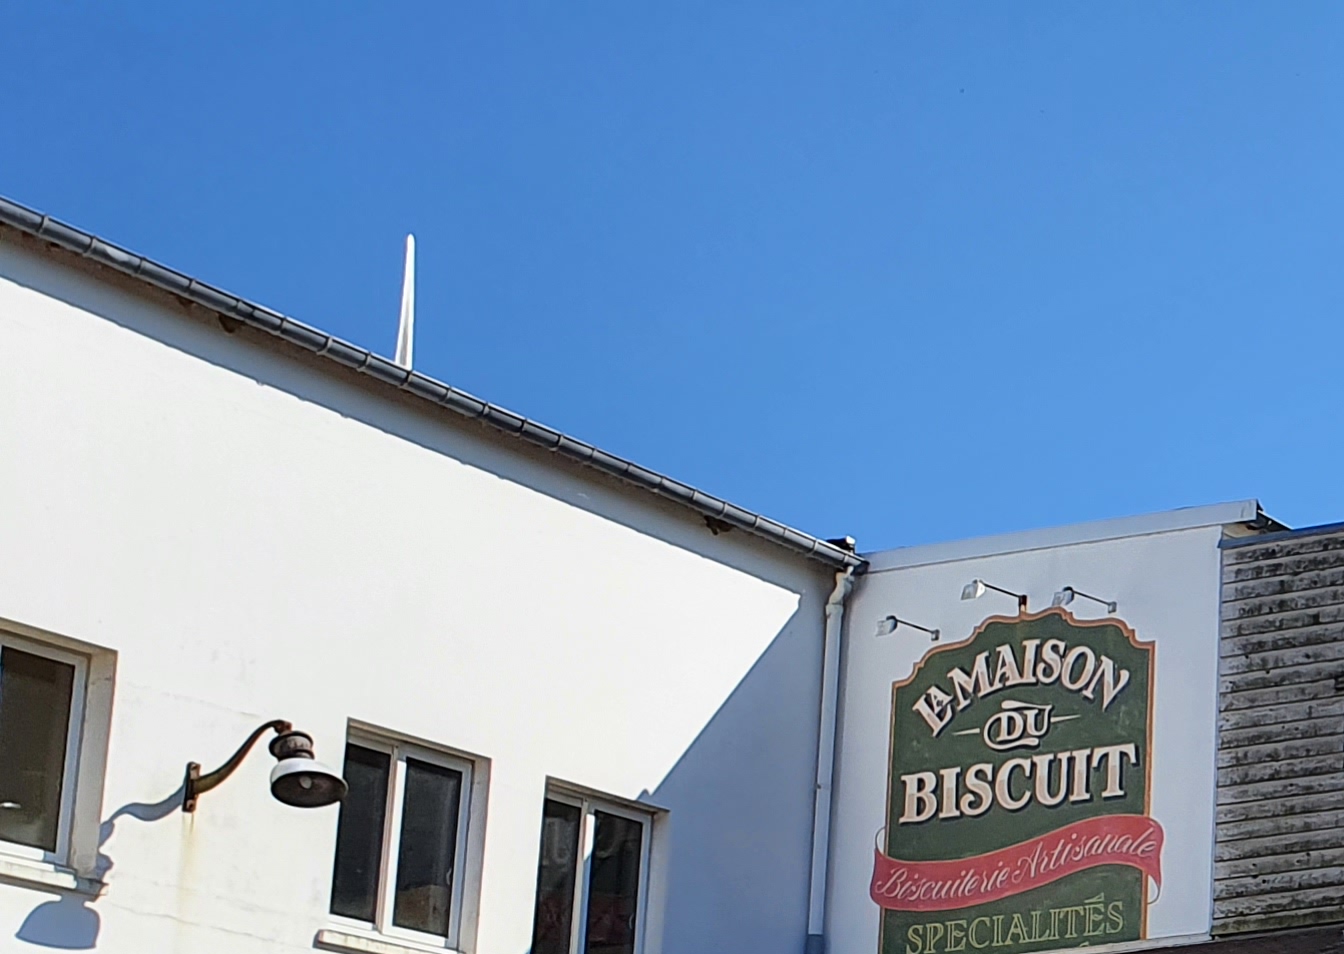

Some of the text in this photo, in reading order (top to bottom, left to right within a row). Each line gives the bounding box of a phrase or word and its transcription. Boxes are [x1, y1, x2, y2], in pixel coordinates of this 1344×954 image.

[913, 638, 1130, 738] LA MAISON
[986, 701, 1052, 748] DU
[899, 743, 1137, 824] BISCUIT
[876, 827, 1158, 902] Biscuiterie Artisanale
